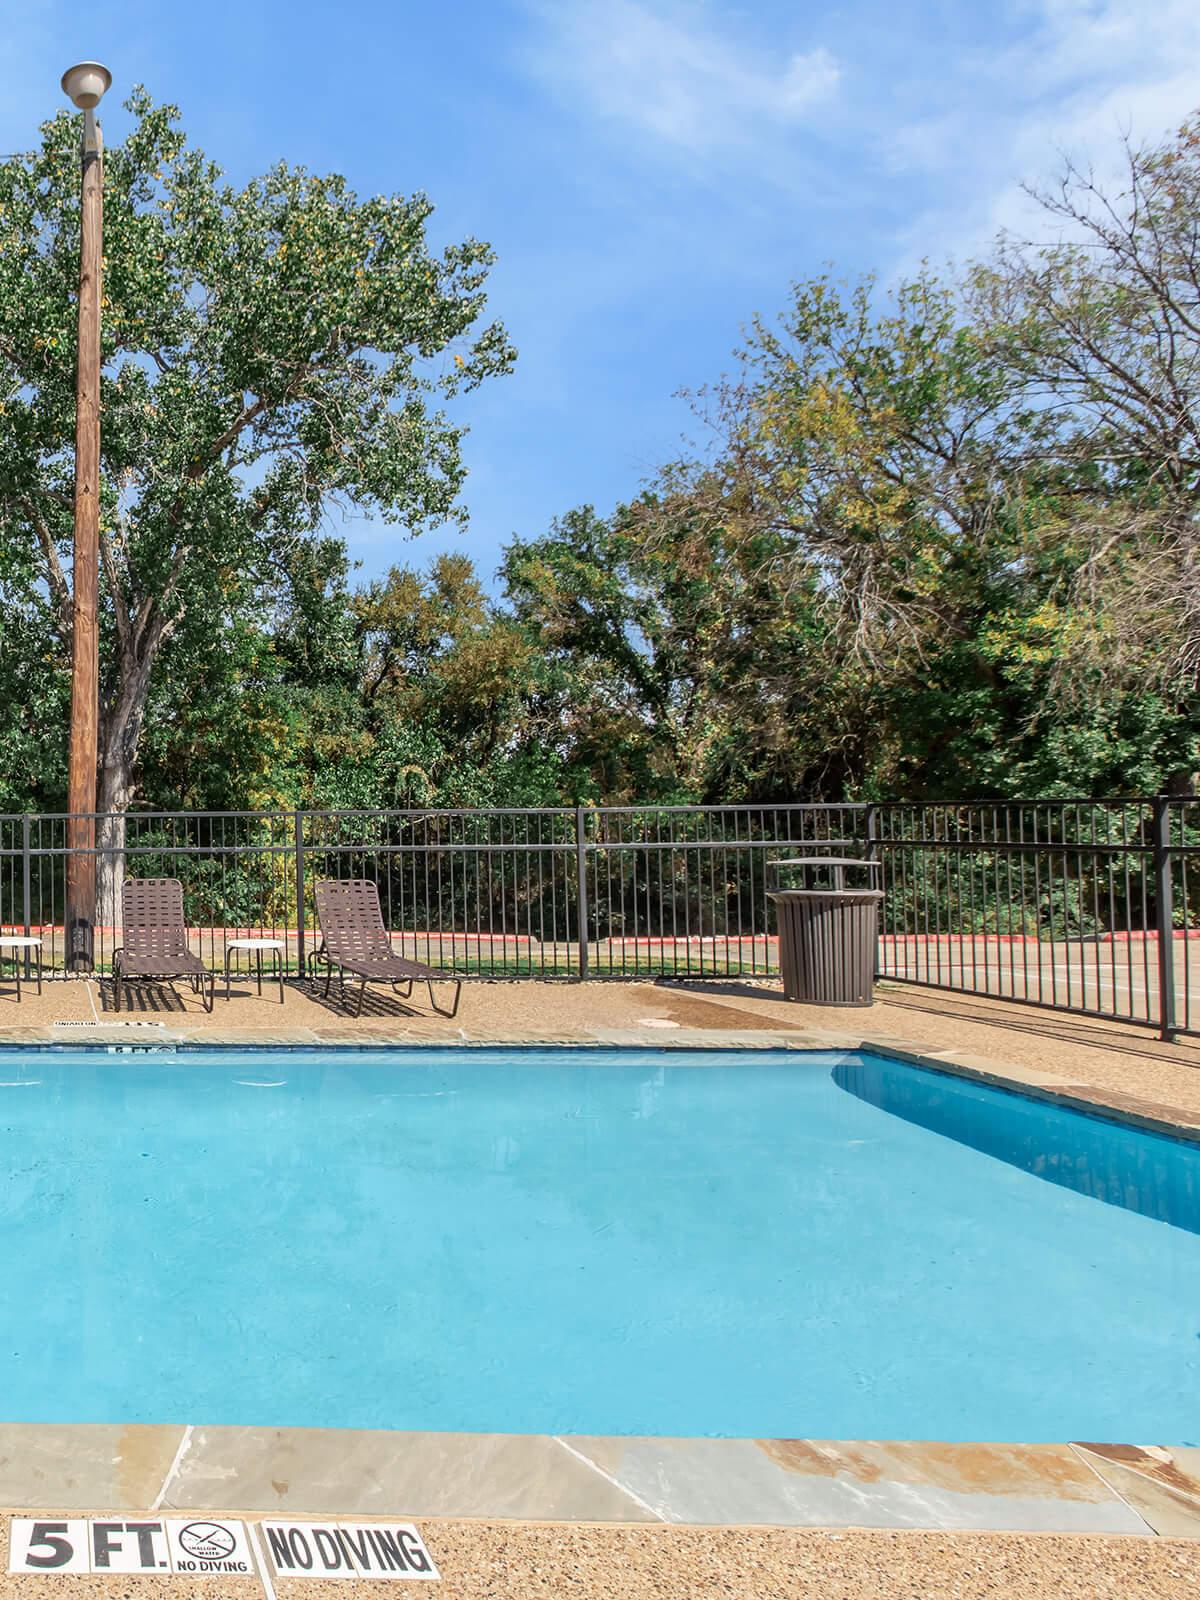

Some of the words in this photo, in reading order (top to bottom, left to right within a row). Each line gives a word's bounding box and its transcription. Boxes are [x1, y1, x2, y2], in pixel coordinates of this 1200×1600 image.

[25, 1522, 75, 1569] 5
[92, 1522, 168, 1568] FT.
[177, 1560, 197, 1571] NO
[200, 1561, 247, 1572] DIVING
[266, 1527, 314, 1569] NO
[316, 1528, 432, 1573] DIVING
